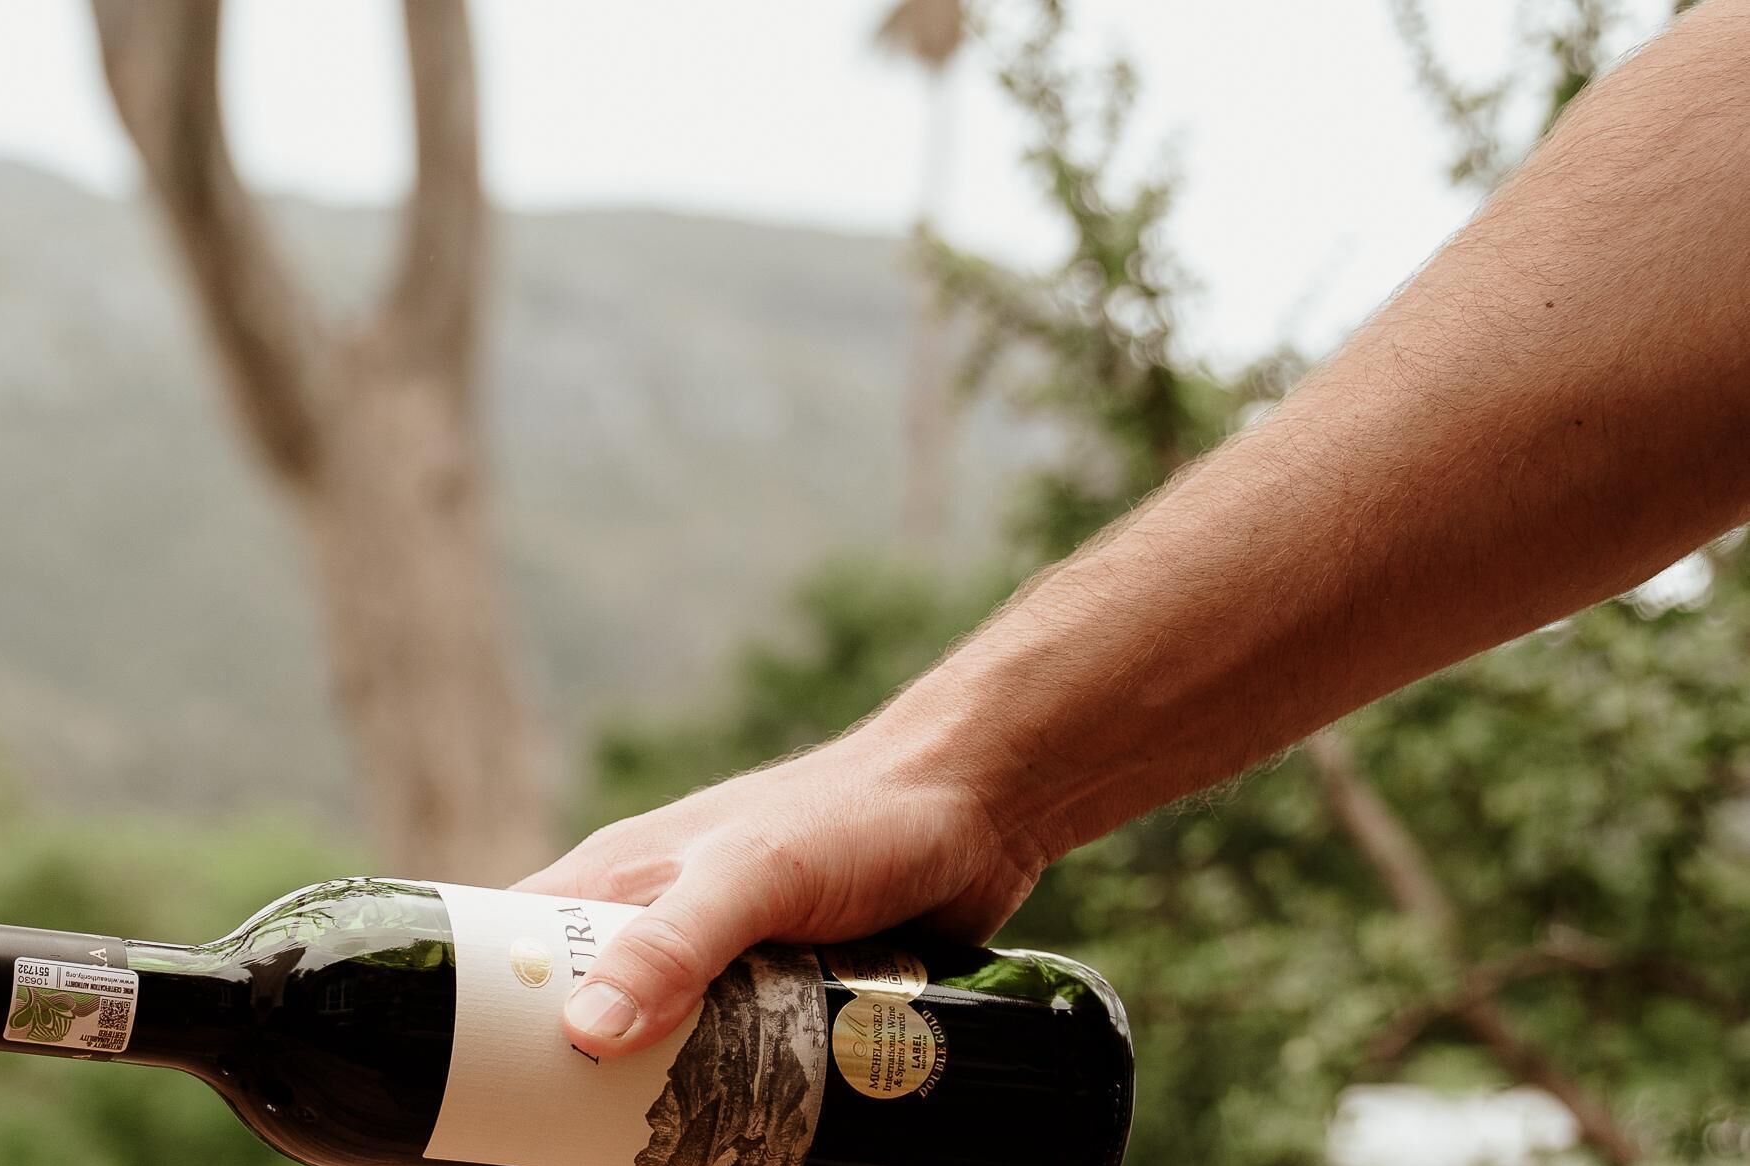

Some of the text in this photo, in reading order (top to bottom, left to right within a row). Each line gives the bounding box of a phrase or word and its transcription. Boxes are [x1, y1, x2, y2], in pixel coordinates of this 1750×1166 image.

[18, 964, 49, 977] 551732
[18, 976, 48, 986] 10630
[65, 980, 89, 990] AUTHORITY
[122, 986, 134, 994] WINE
[869, 1004, 883, 1090] MICHELANGELO
[883, 1006, 896, 1092] International Wine
[893, 1013, 906, 1087] & Spirits Awards
[912, 1034, 921, 1069] LABEL
[918, 1010, 947, 1098] DOUBLE GOLD
